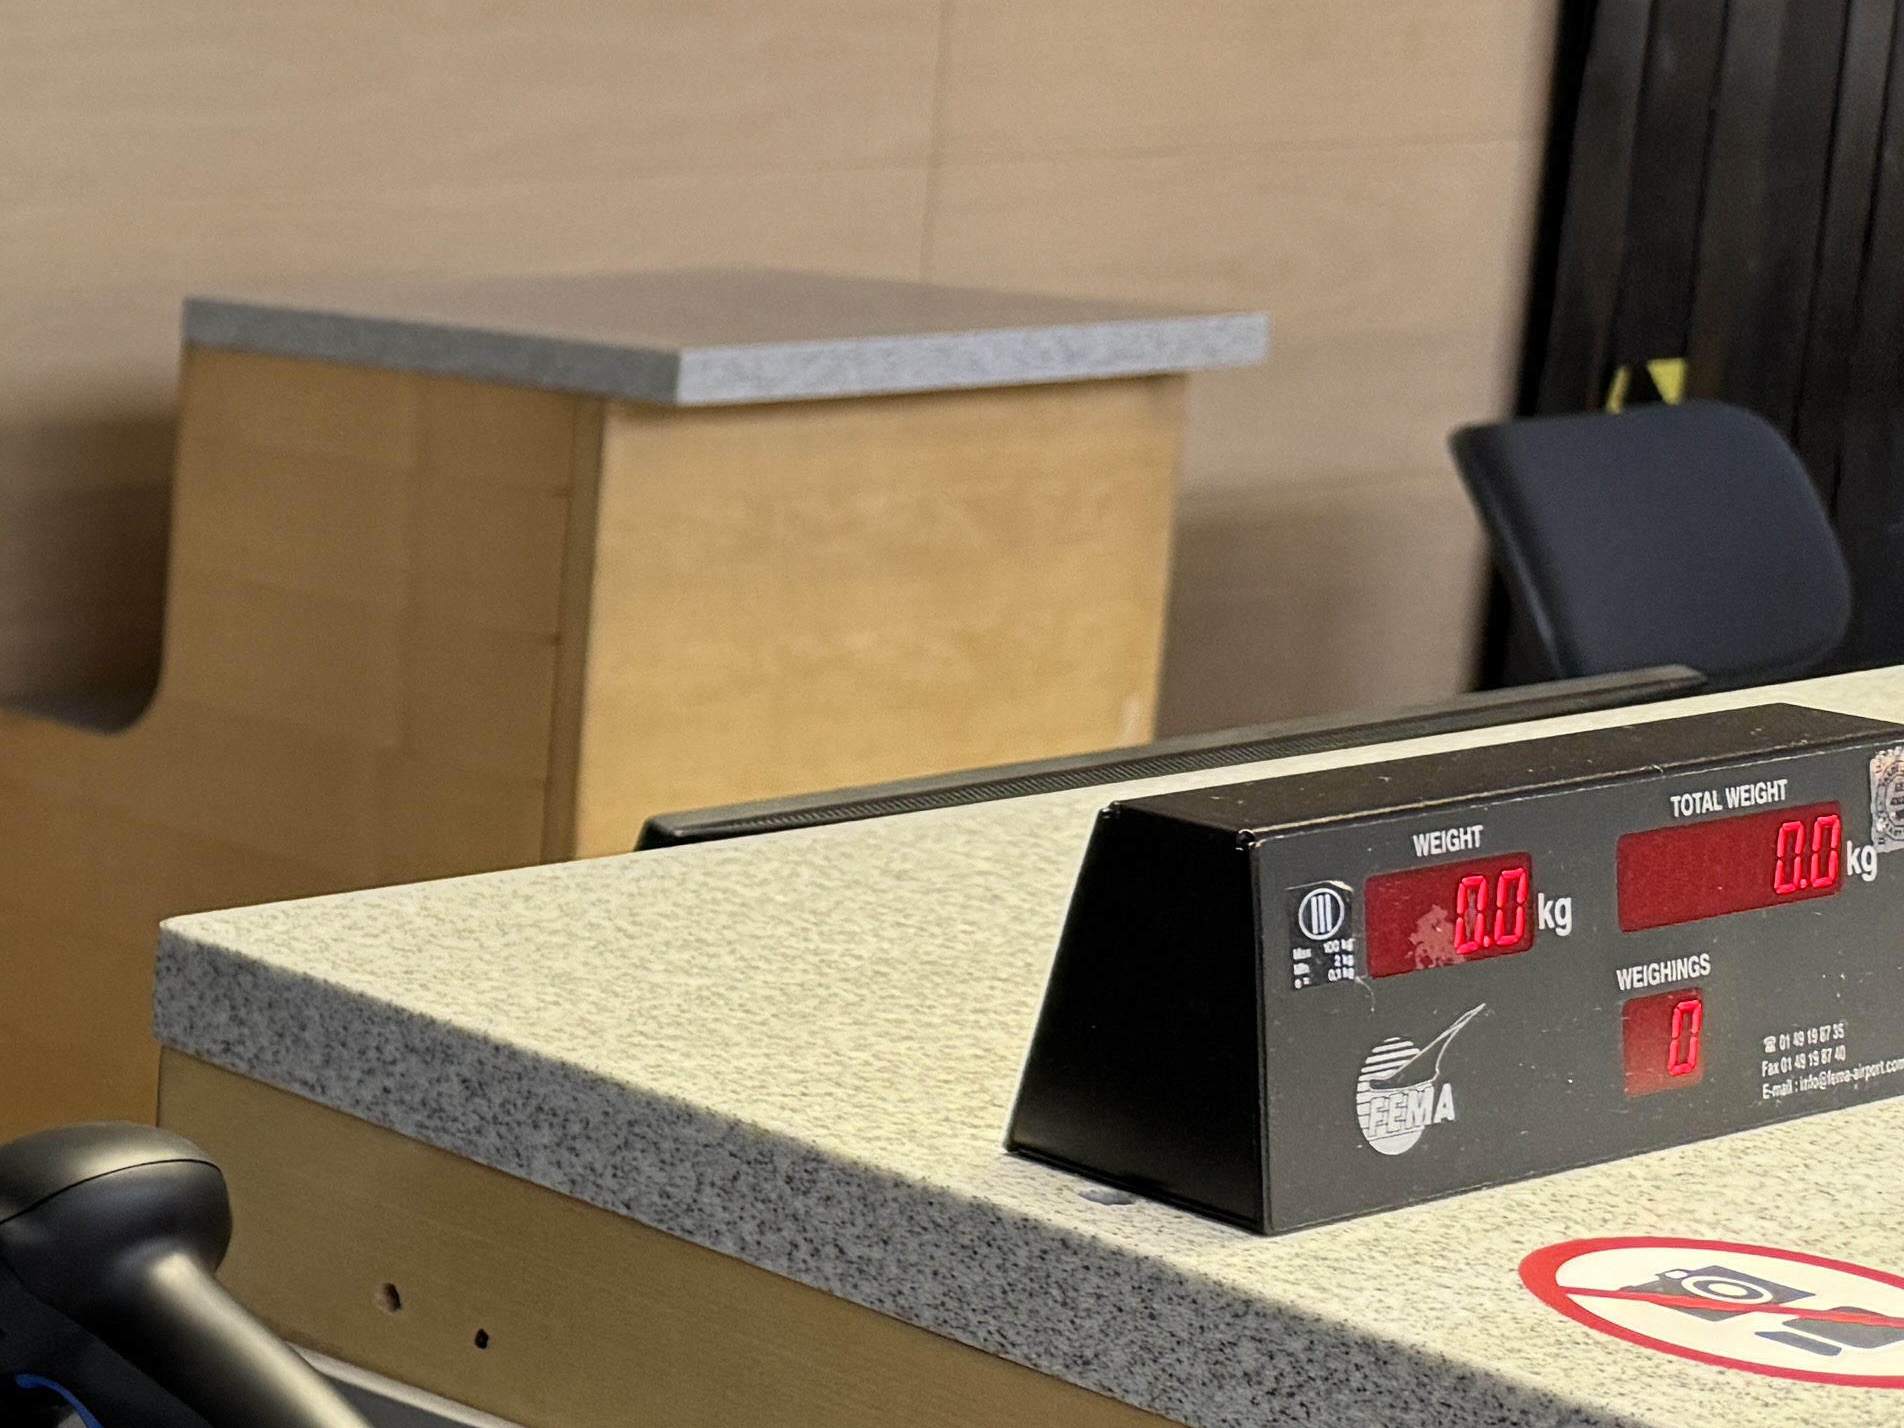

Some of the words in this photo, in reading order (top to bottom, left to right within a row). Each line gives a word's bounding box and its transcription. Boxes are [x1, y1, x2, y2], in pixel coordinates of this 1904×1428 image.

[1671, 790, 1722, 817] TOTAL
[1725, 779, 1788, 810] WEIGHT
[1413, 825, 1484, 857] WEIGHT
[1774, 814, 1840, 895] 0.0
[1847, 840, 1877, 881] kg
[1454, 868, 1528, 954] 0.0
[1538, 893, 1572, 936] kg
[1323, 940, 1340, 953] 100
[1334, 954, 1341, 966] 2
[1616, 954, 1711, 990] WEIGHINGS
[1667, 1000, 1701, 1077] 0
[1779, 1034, 1790, 1050] 01
[1793, 1031, 1804, 1046] 49
[1807, 1028, 1818, 1044] 19
[1762, 1060, 1780, 1077] Fax
[1781, 1056, 1792, 1073] 01
[1794, 1053, 1806, 1069] 49
[1808, 1050, 1819, 1067] 19
[1762, 1079, 1792, 1099] E-mail
[1368, 1083, 1455, 1137] FEMA
